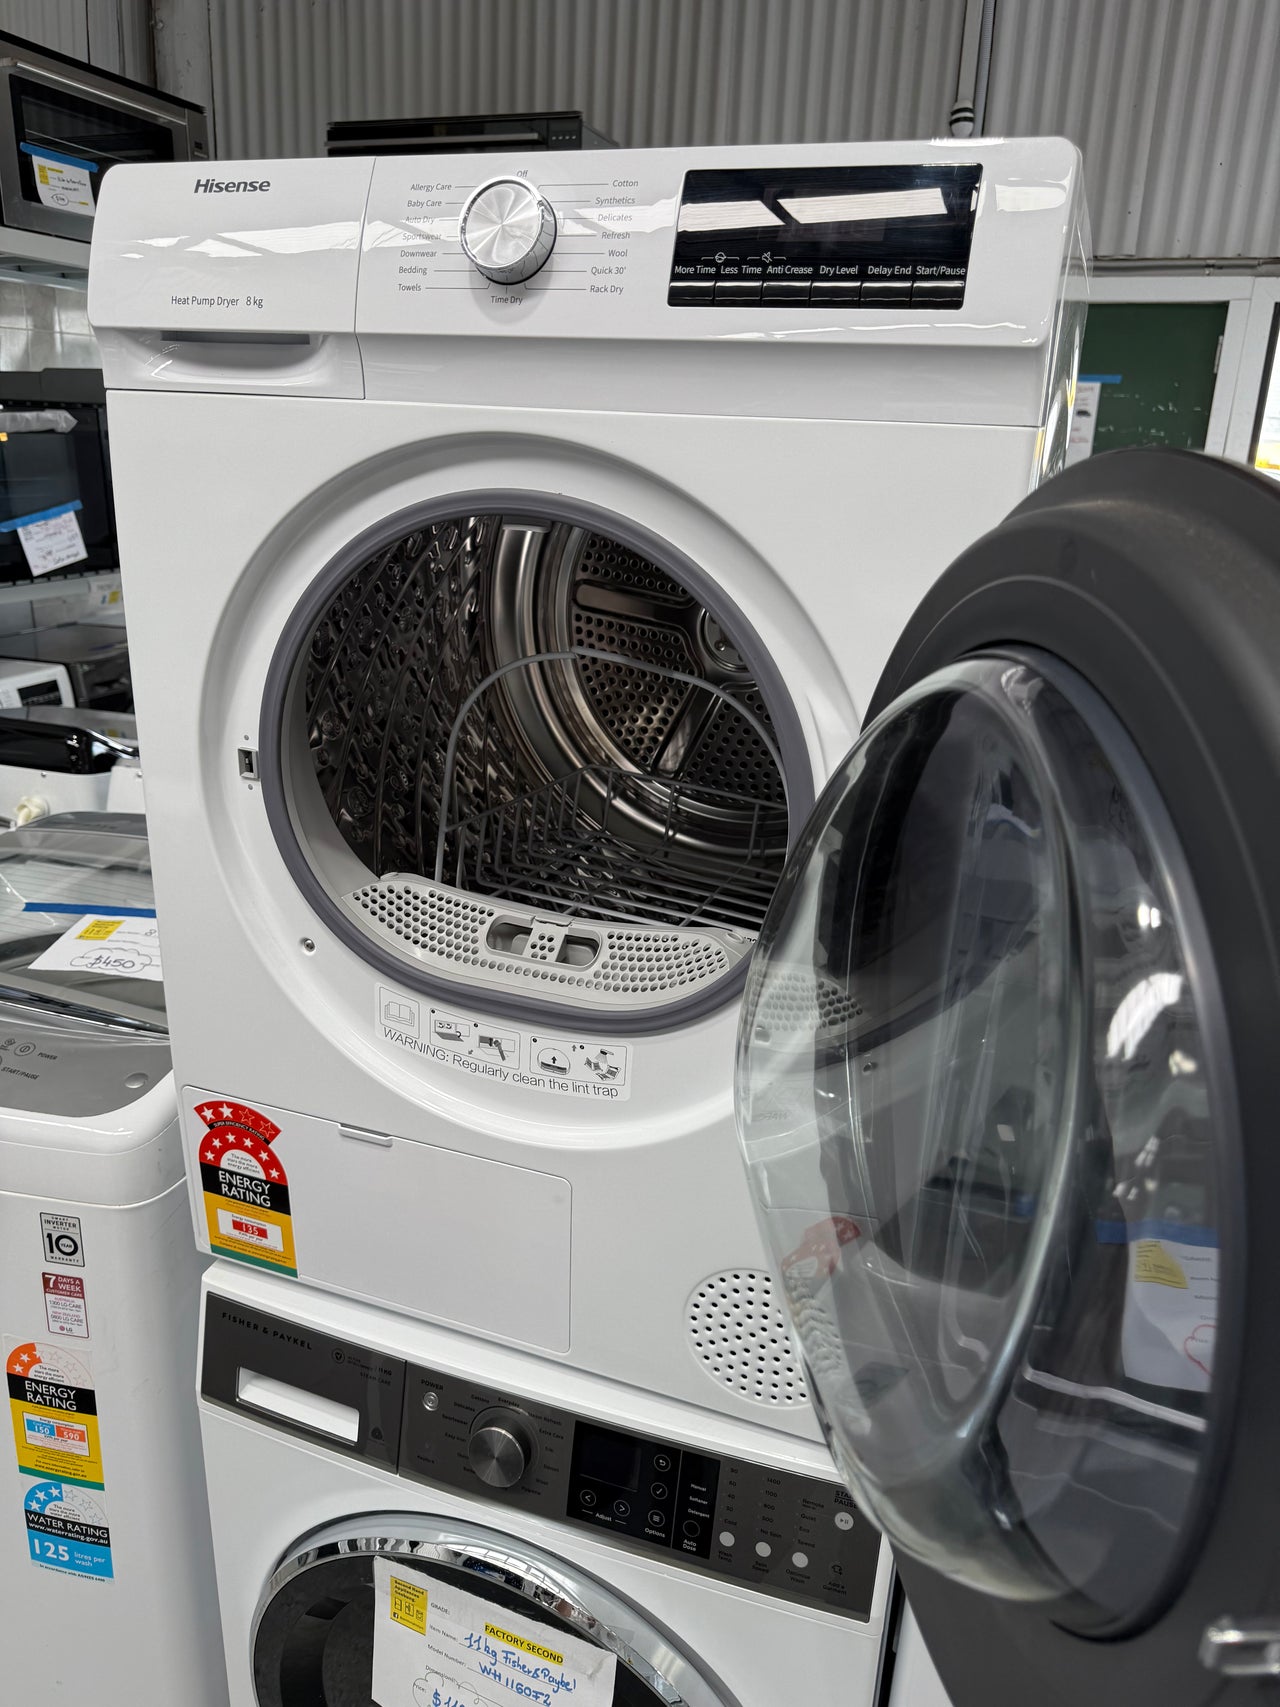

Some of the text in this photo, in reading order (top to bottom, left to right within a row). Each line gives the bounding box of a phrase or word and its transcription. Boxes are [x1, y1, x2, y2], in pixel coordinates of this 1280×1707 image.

[194, 179, 270, 193] Hisense
[411, 183, 434, 192] Allergy
[407, 200, 424, 208] Baby
[595, 197, 635, 206] Synthetics
[402, 233, 442, 241] Sportswear
[398, 266, 427, 276] Bedding
[591, 267, 613, 275] Quick
[675, 266, 716, 274] More Time
[720, 266, 762, 274] Less Time
[767, 266, 813, 274] Anti Crease
[819, 266, 858, 276] Dry Level
[868, 266, 912, 276] Delay End
[916, 266, 966, 276] Start/Pause
[610, 286, 623, 295] Dry
[171, 296, 263, 308] Heat Pump Dryer 8 kg
[510, 296, 523, 305] Dry
[90, 955, 136, 969] $450
[37, 1052, 58, 1060] POWER
[383, 1027, 619, 1099] WARNING: Regularly clean the lint trap
[1, 1066, 40, 1080] START/PAUSE
[249, 1128, 265, 1141] RATING
[218, 1171, 271, 1195] ENERGY
[221, 1186, 271, 1207] RATING
[44, 1219, 76, 1228] INVERTER
[242, 1223, 258, 1235] 135
[46, 1233, 79, 1256] 10
[45, 1274, 56, 1288] 7
[58, 1277, 74, 1285] DAYS
[58, 1284, 81, 1293] WEEK
[222, 1312, 258, 1331] FISHER
[273, 1331, 313, 1351] PAYKEL
[25, 1380, 76, 1400] ENERGY
[421, 1379, 444, 1391] POWER
[27, 1392, 77, 1411] RATING
[35, 1426, 50, 1435] 150
[64, 1432, 80, 1441] 590
[767, 1478, 781, 1486] 1400
[595, 1512, 612, 1522] Adjust
[27, 1512, 108, 1538] WATER RATING
[29, 1522, 108, 1545] www.waterrating.gov.au
[644, 1528, 666, 1539] Options
[683, 1539, 697, 1547] Auto
[683, 1544, 697, 1552] Dose
[34, 1538, 69, 1562] 125
[74, 1552, 106, 1565] litres per
[74, 1560, 93, 1568] wash
[412, 1586, 425, 1595] Hand
[430, 1602, 451, 1615] GRADE:
[485, 1625, 564, 1664] FACTORY SECOND
[427, 1644, 444, 1656] Model
